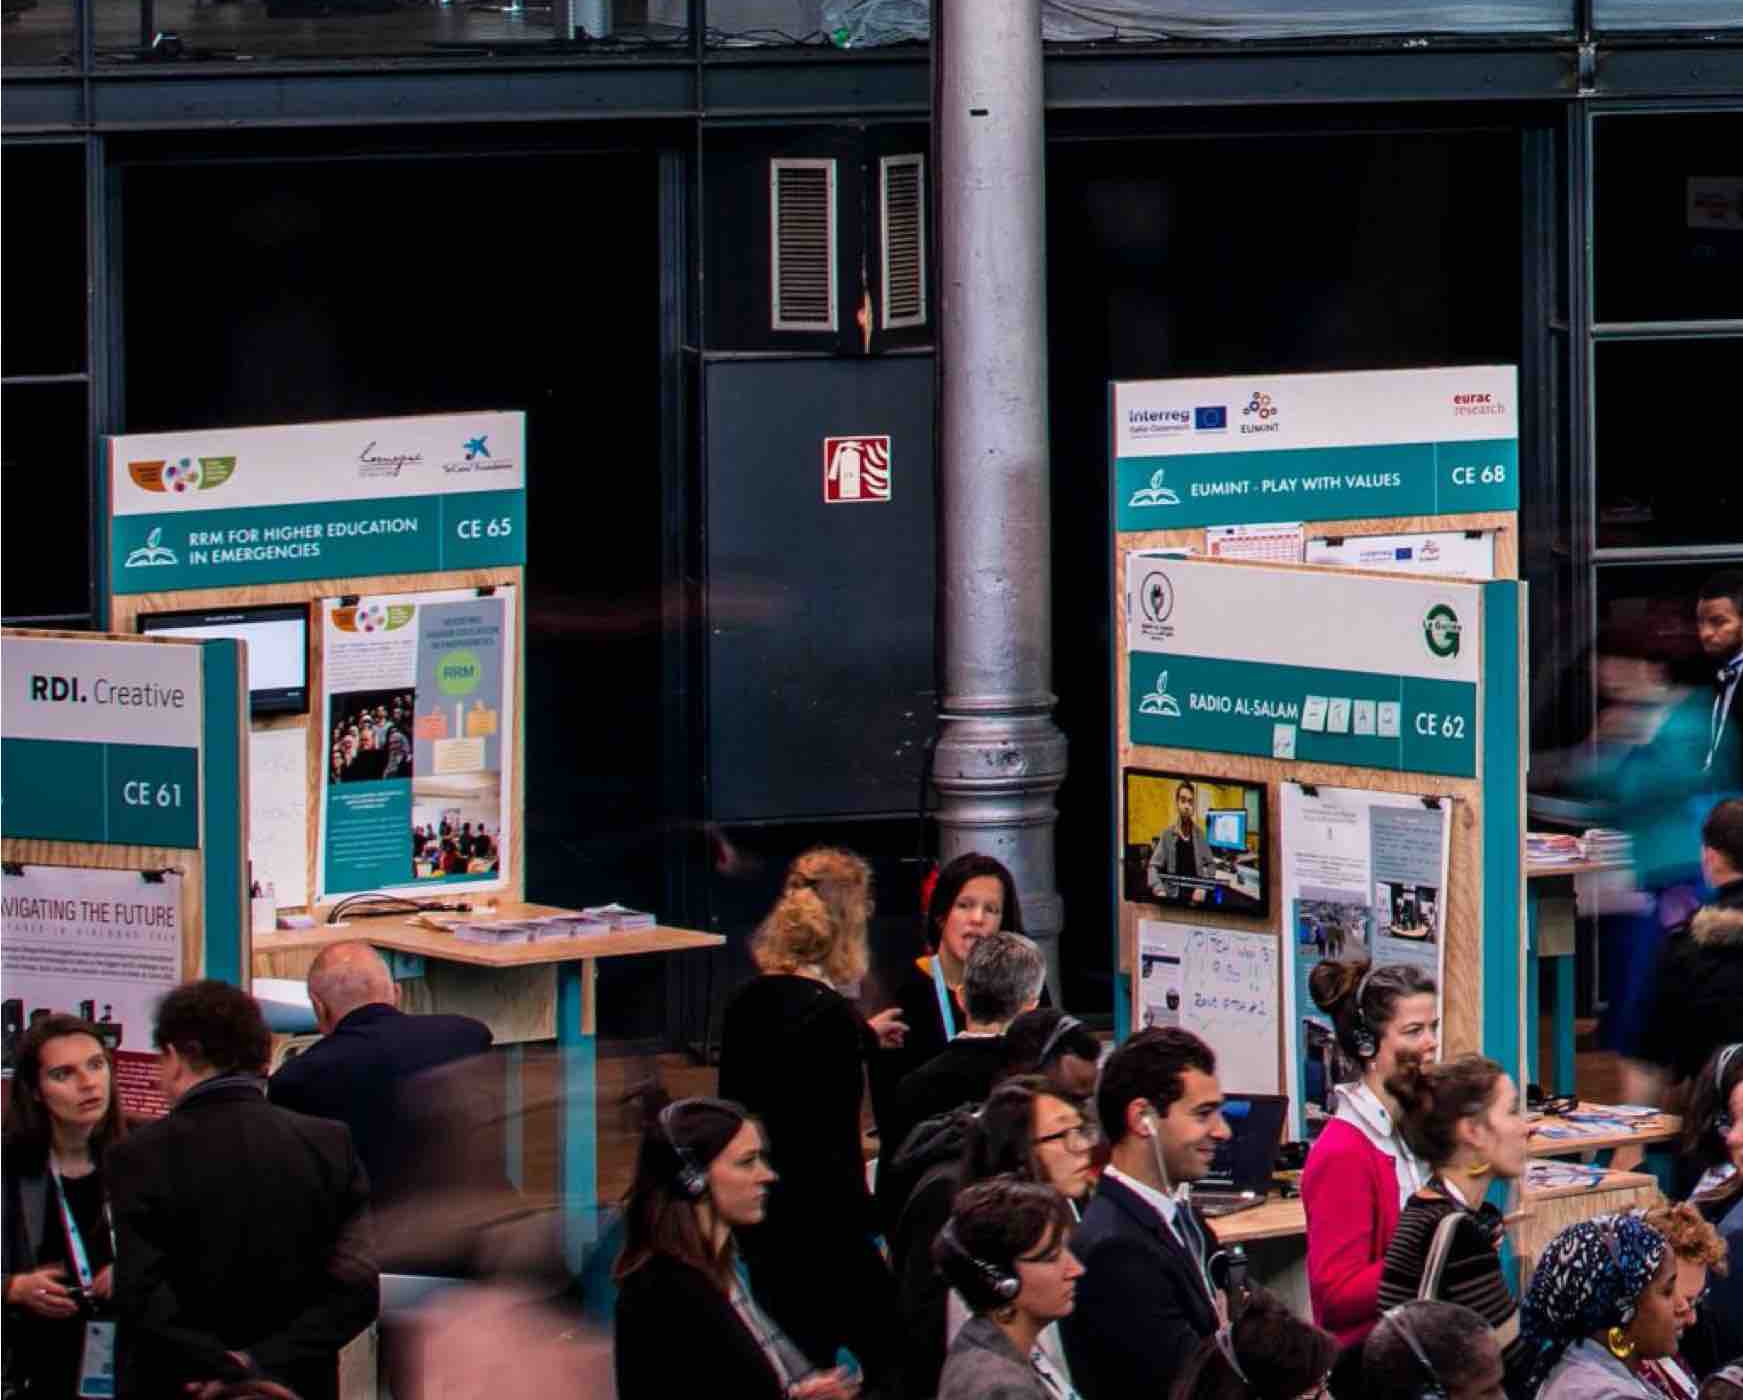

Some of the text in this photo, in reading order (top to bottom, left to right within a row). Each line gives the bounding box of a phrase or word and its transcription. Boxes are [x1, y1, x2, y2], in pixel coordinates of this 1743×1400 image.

[1454, 393, 1491, 405] eurac
[1454, 403, 1505, 417] research
[1240, 423, 1279, 434] EUMINT
[1191, 480, 1249, 497] EUMINT
[1262, 478, 1297, 495] PLAY
[1302, 475, 1341, 492] WITH
[1346, 472, 1401, 489] VALUES
[1452, 466, 1505, 485] CE 68
[189, 518, 418, 547] RRM FOR HIGHER EDUCATION
[457, 518, 512, 539] CE 65
[190, 542, 320, 565] IN EMERGENCIES
[443, 665, 475, 680] RRM
[32, 675, 185, 708] RDI. Creative
[1190, 693, 1298, 719] RADIO AL-SALAM
[1416, 713, 1465, 738] CE 62
[124, 781, 181, 807] CE 61
[80, 900, 110, 924] THE
[115, 903, 175, 928] FUTURE
